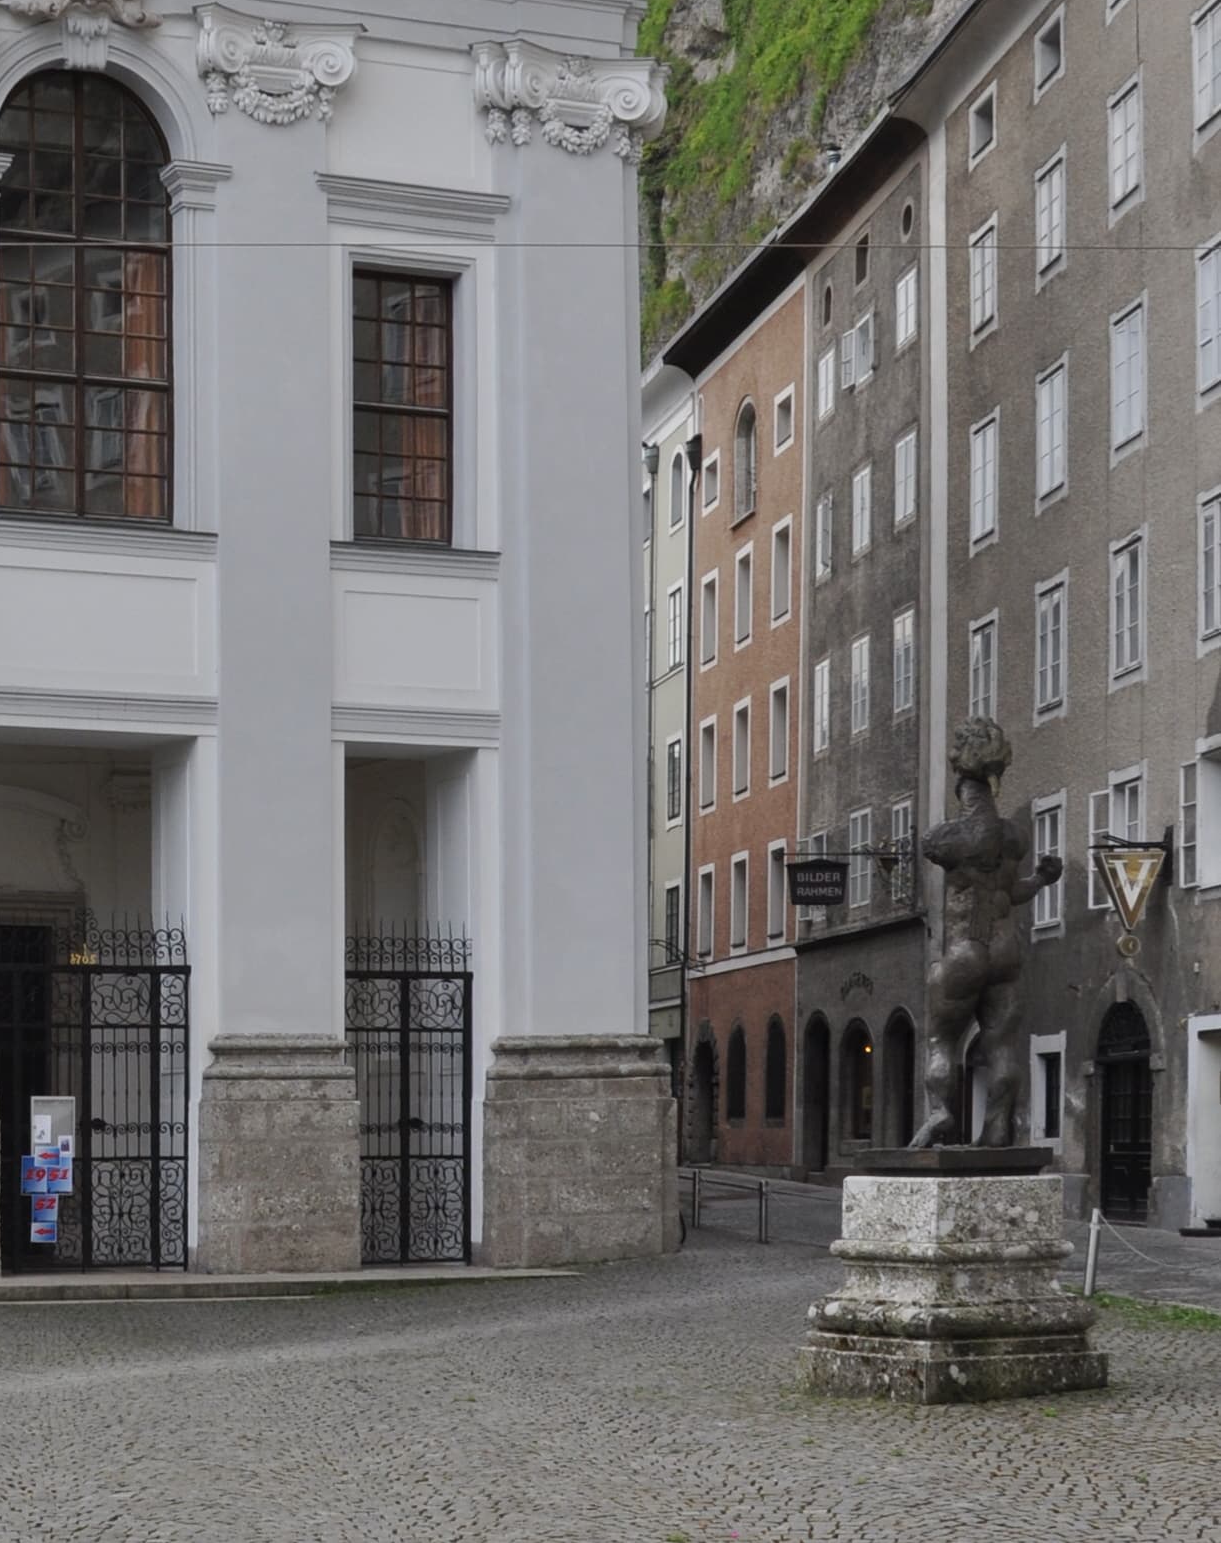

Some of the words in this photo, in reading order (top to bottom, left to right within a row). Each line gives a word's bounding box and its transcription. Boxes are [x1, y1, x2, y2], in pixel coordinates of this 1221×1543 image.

[796, 872, 841, 882] BILDER
[1108, 859, 1158, 911] V
[796, 886, 843, 897] RAHMEN
